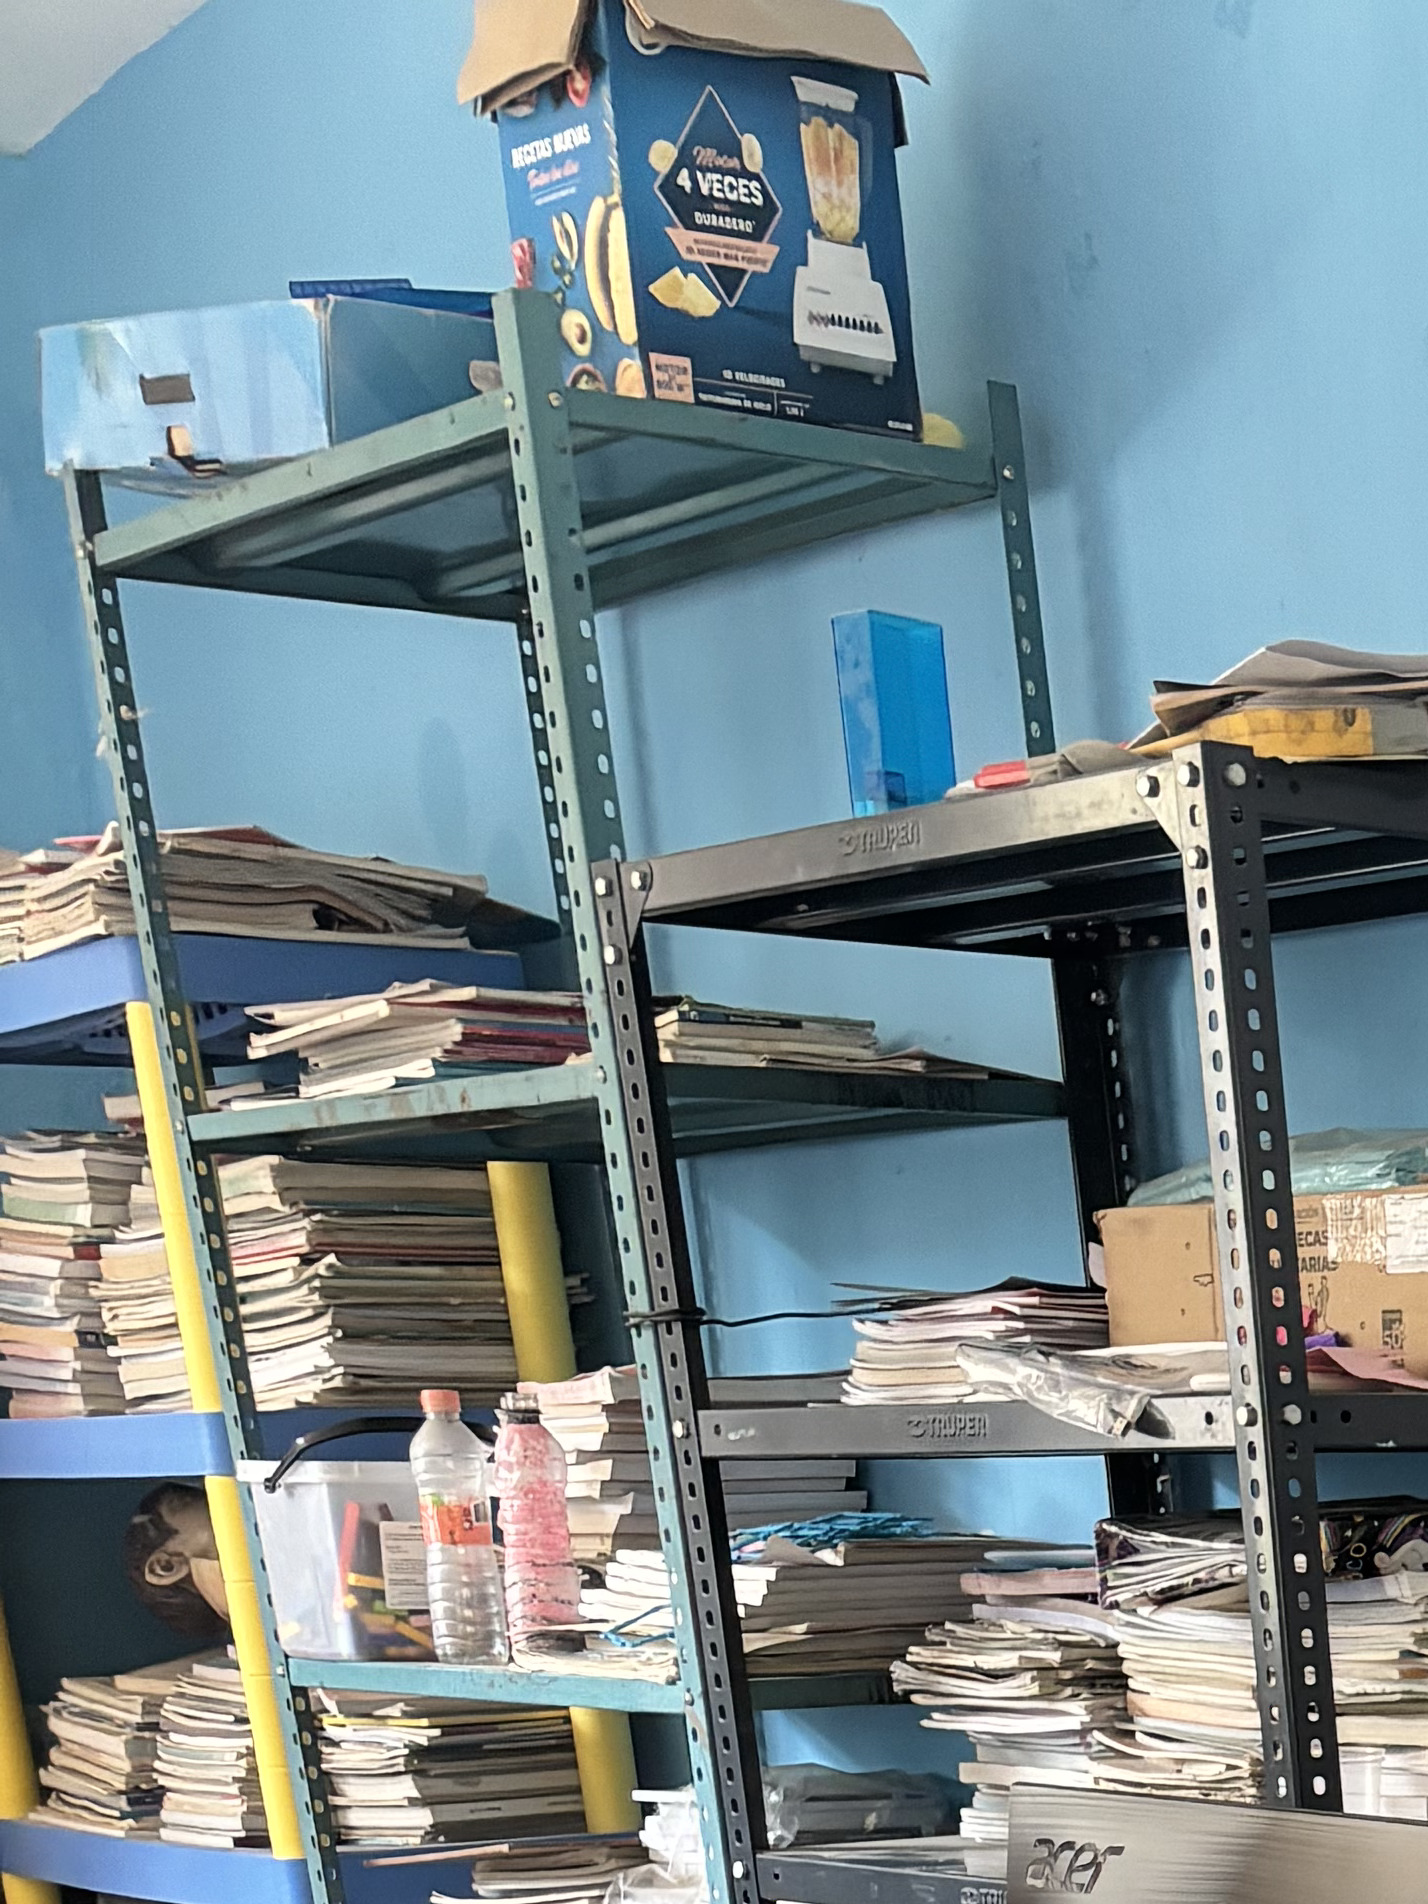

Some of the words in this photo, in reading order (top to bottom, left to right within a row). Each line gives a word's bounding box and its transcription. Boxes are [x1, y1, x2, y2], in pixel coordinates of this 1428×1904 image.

[676, 167, 692, 194] 4
[696, 169, 764, 207] VECES
[1026, 1838, 1125, 1894] acer
